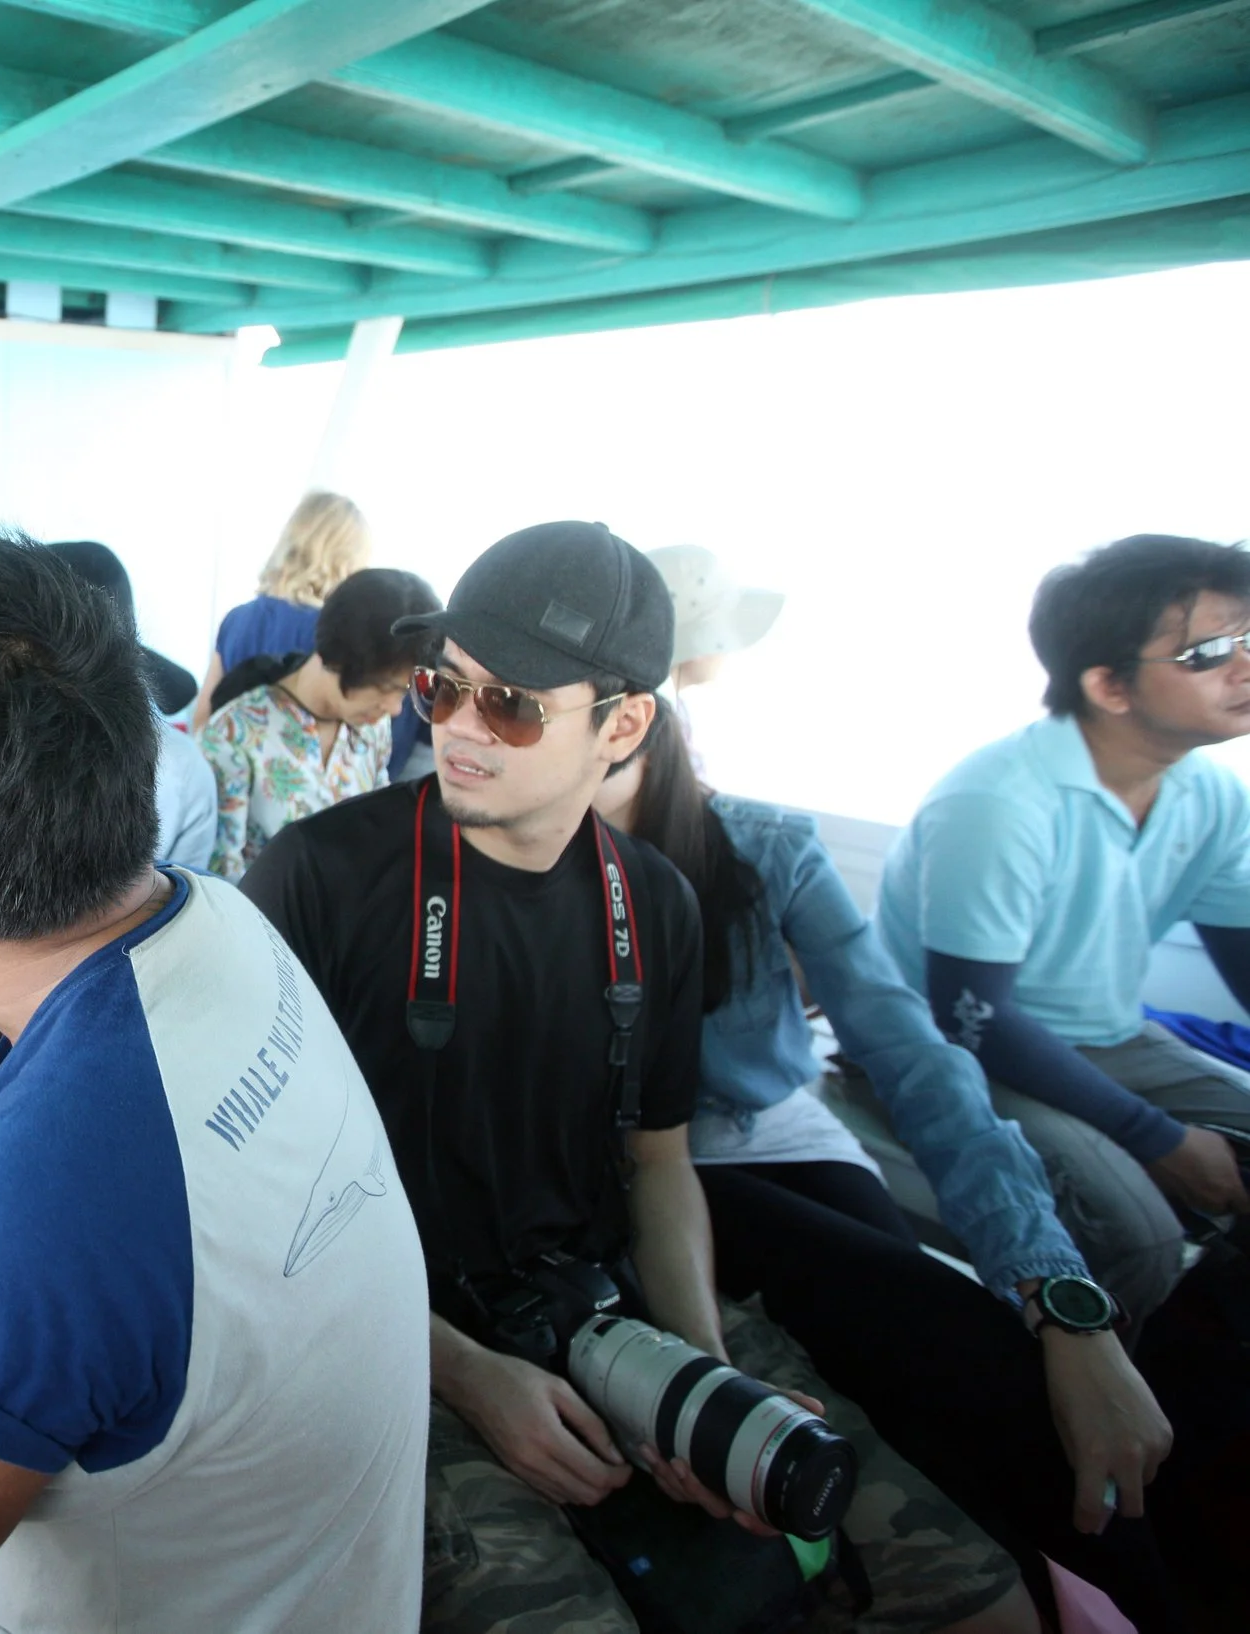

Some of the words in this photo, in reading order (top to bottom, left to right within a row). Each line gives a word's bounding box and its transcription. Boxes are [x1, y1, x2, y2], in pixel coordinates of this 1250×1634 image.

[605, 862, 626, 921] EOS
[423, 895, 447, 979] Canon
[613, 926, 630, 958] 7D
[205, 1046, 290, 1152] WHALE
[811, 1465, 845, 1518] Canon
